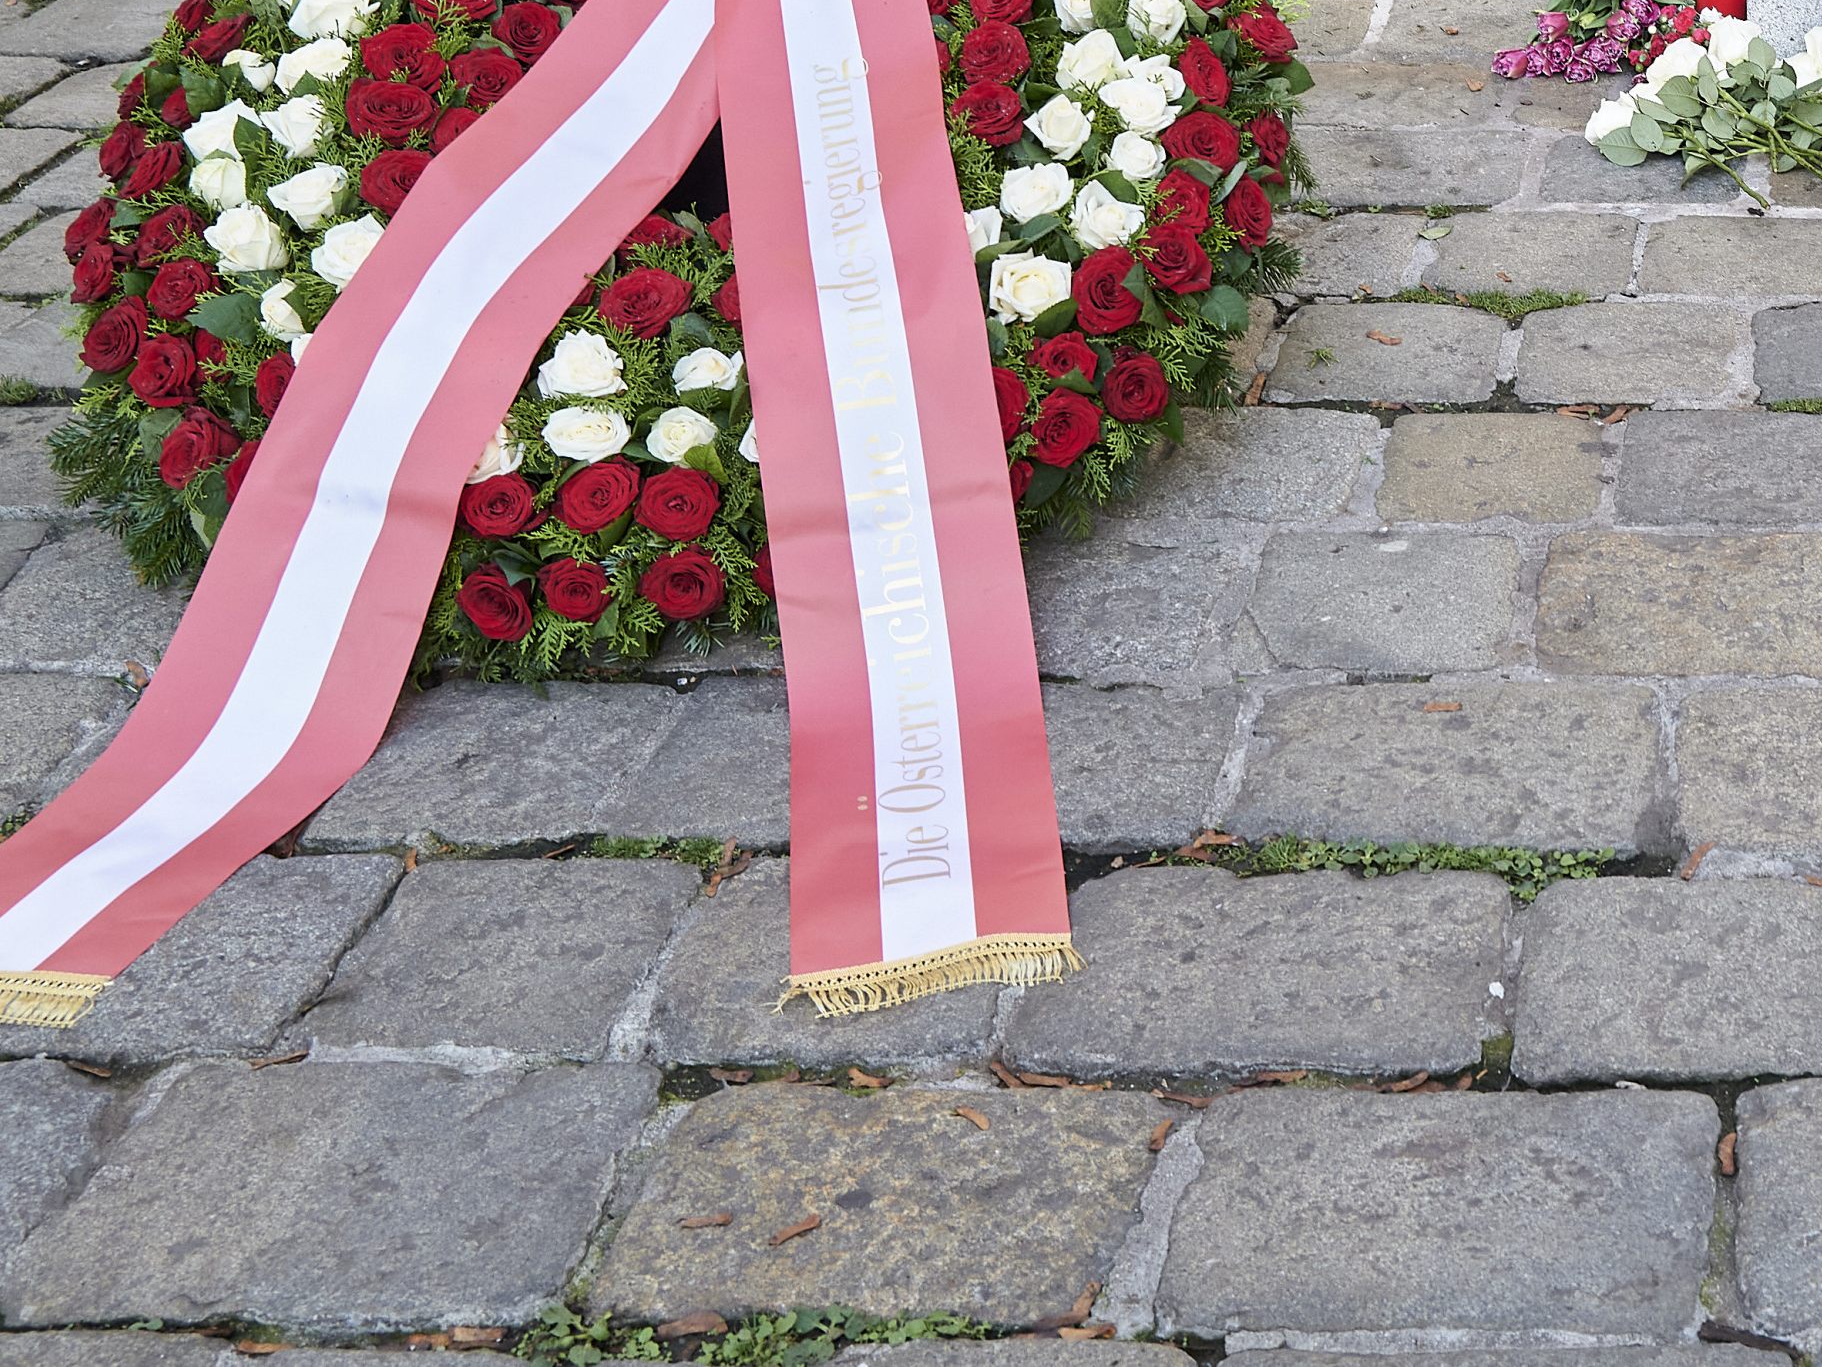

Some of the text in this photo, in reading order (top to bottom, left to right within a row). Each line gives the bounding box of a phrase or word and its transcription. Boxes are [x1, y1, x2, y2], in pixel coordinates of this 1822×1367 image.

[804, 57, 952, 890] Die Österreichische Bundesregierung
